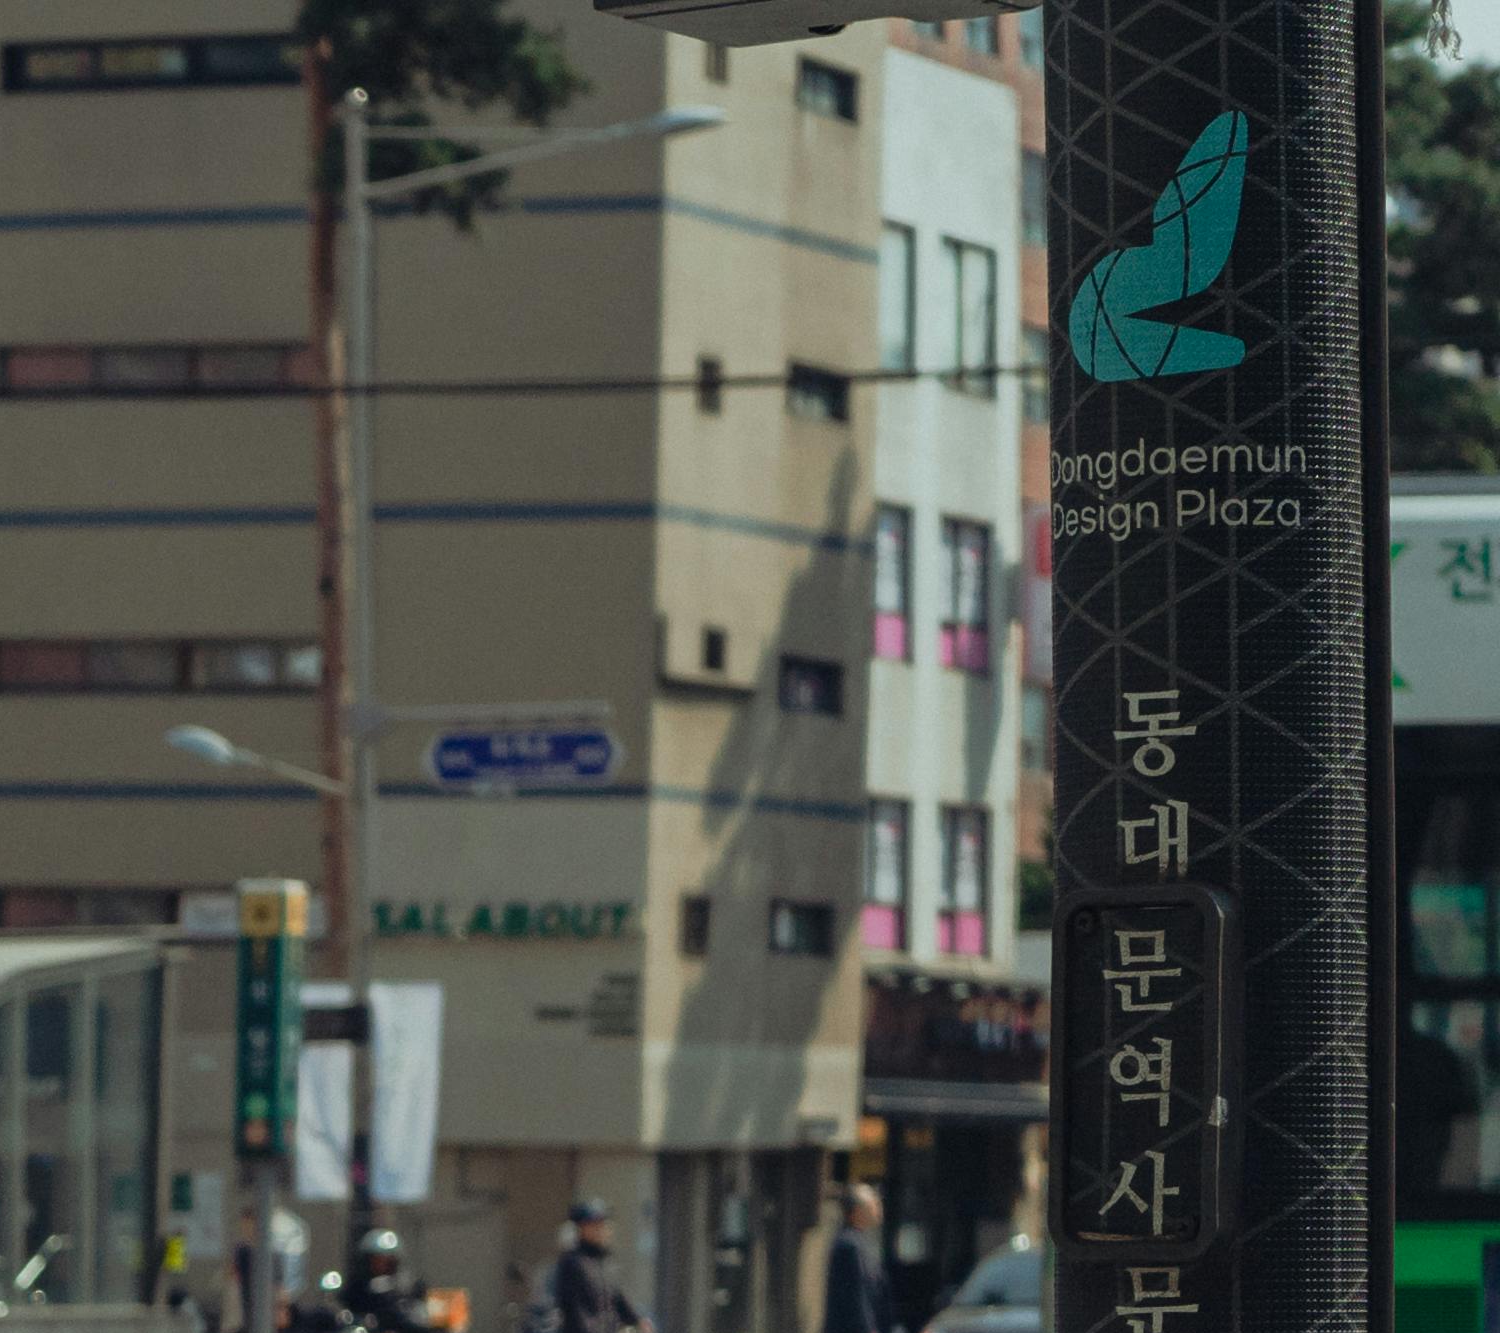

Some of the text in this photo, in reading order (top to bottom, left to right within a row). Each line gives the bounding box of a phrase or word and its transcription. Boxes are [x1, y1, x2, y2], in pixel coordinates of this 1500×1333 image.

[1051, 438, 1306, 491] Dongdaemun
[1053, 490, 1302, 542] Design Plaza
[1436, 534, 1498, 602] 전
